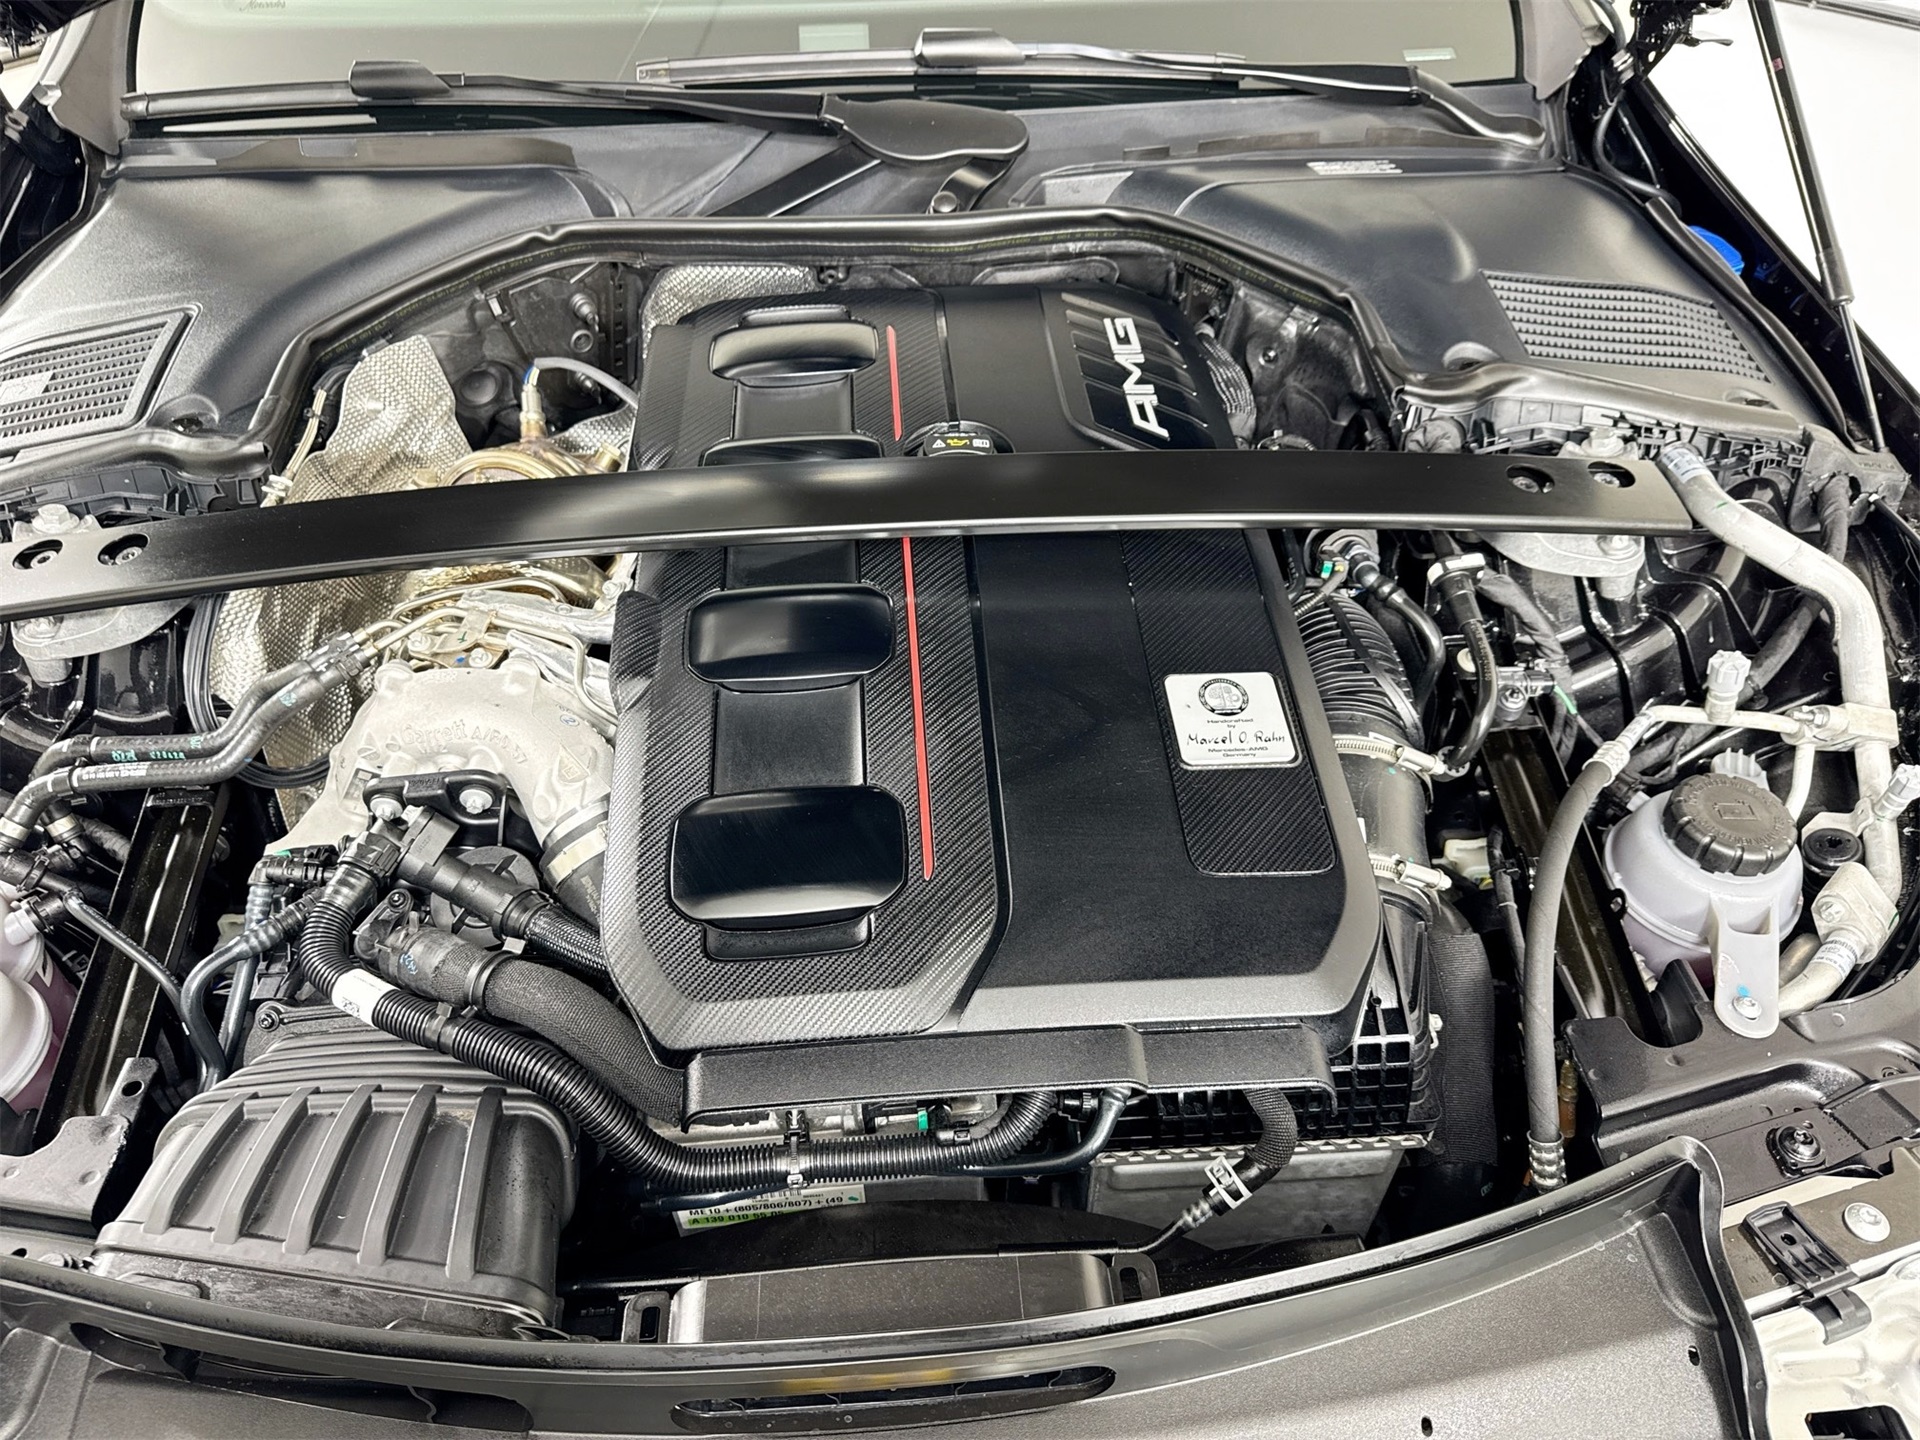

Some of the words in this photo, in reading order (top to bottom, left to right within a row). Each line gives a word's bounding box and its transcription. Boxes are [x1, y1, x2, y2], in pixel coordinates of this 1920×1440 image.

[1103, 318, 1170, 438] AMG
[1186, 730, 1232, 746] Marcel
[1254, 730, 1285, 743] Rahn
[734, 1200, 812, 1214] (805/806/807)
[692, 1217, 700, 1225] A
[704, 1214, 725, 1224] 139
[728, 1212, 749, 1221] 010
